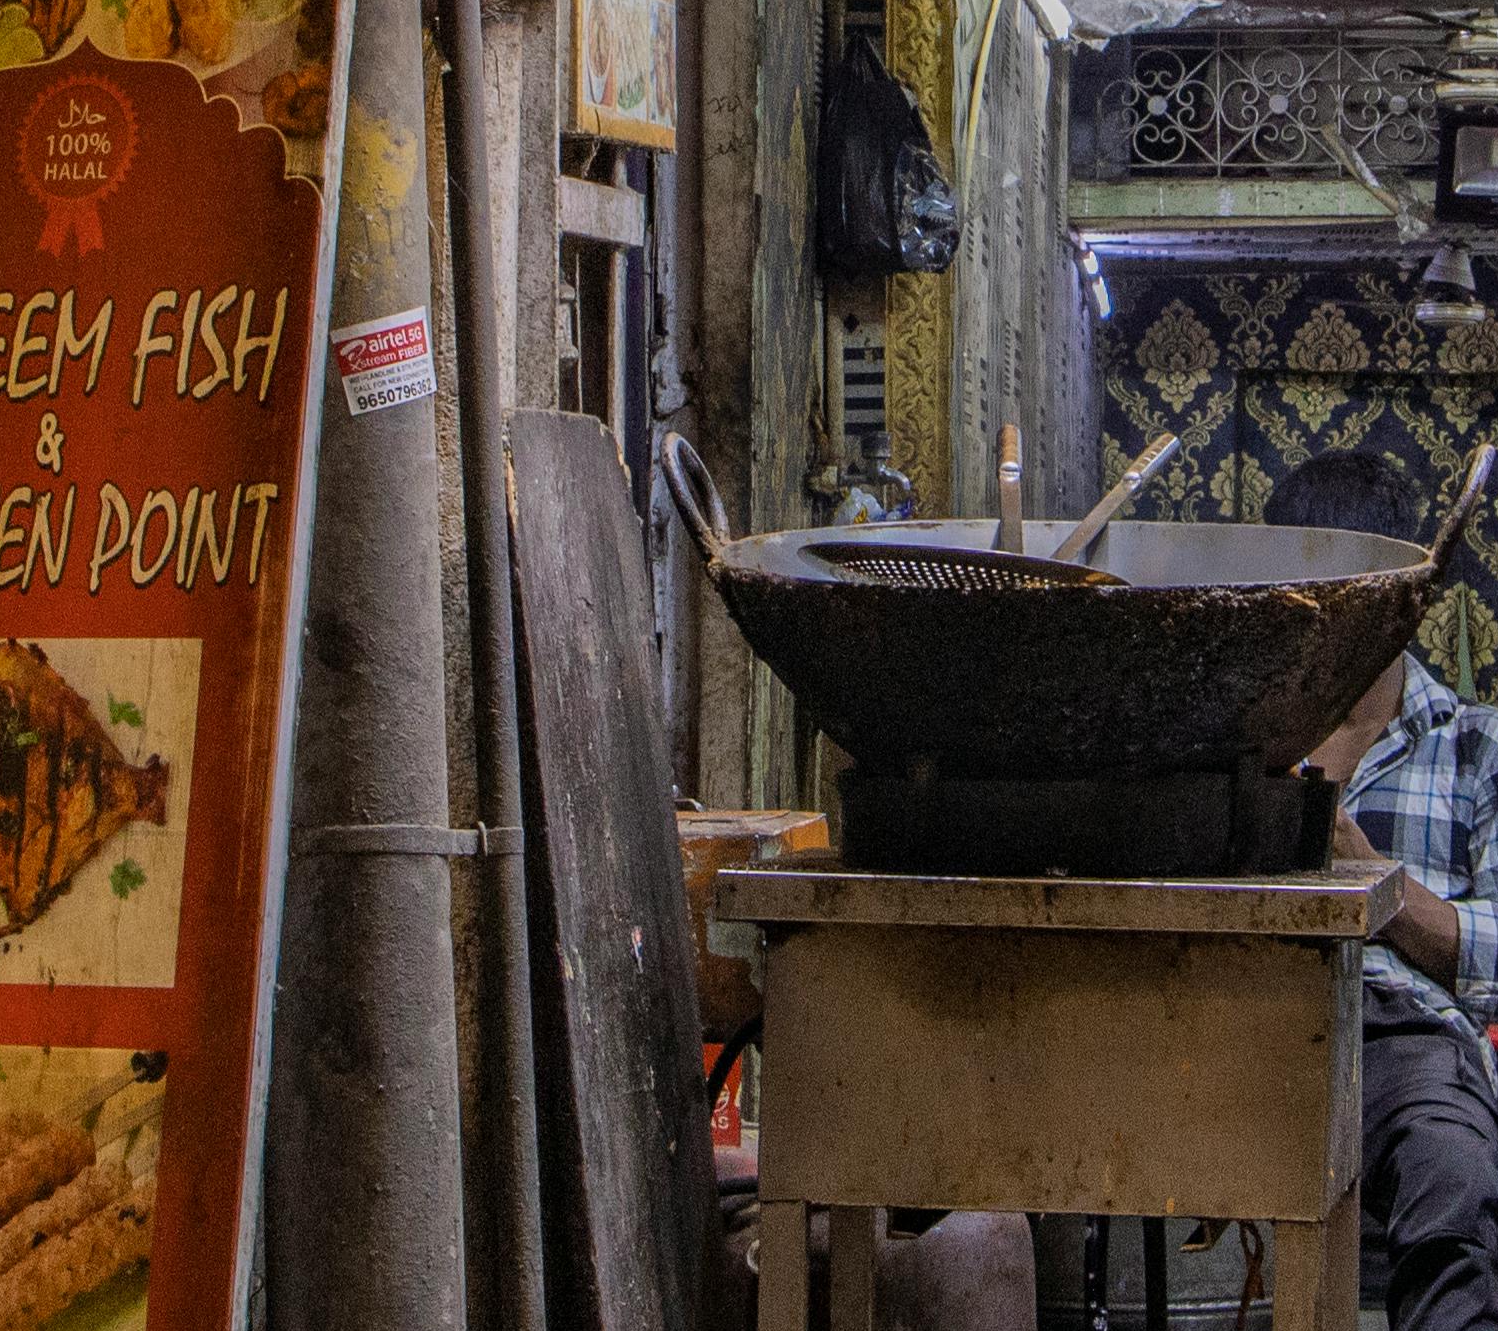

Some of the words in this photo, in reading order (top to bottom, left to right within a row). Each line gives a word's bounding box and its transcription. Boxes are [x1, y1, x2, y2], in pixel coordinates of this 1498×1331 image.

[57, 97, 107, 128] حلال
[46, 131, 111, 156] 100%
[43, 159, 108, 182] HALAL
[132, 283, 288, 406] FISH
[370, 329, 407, 352] airtel
[408, 326, 423, 342] 5G
[398, 343, 424, 360] FIBER
[35, 411, 64, 473] &
[88, 481, 279, 592] POINT
